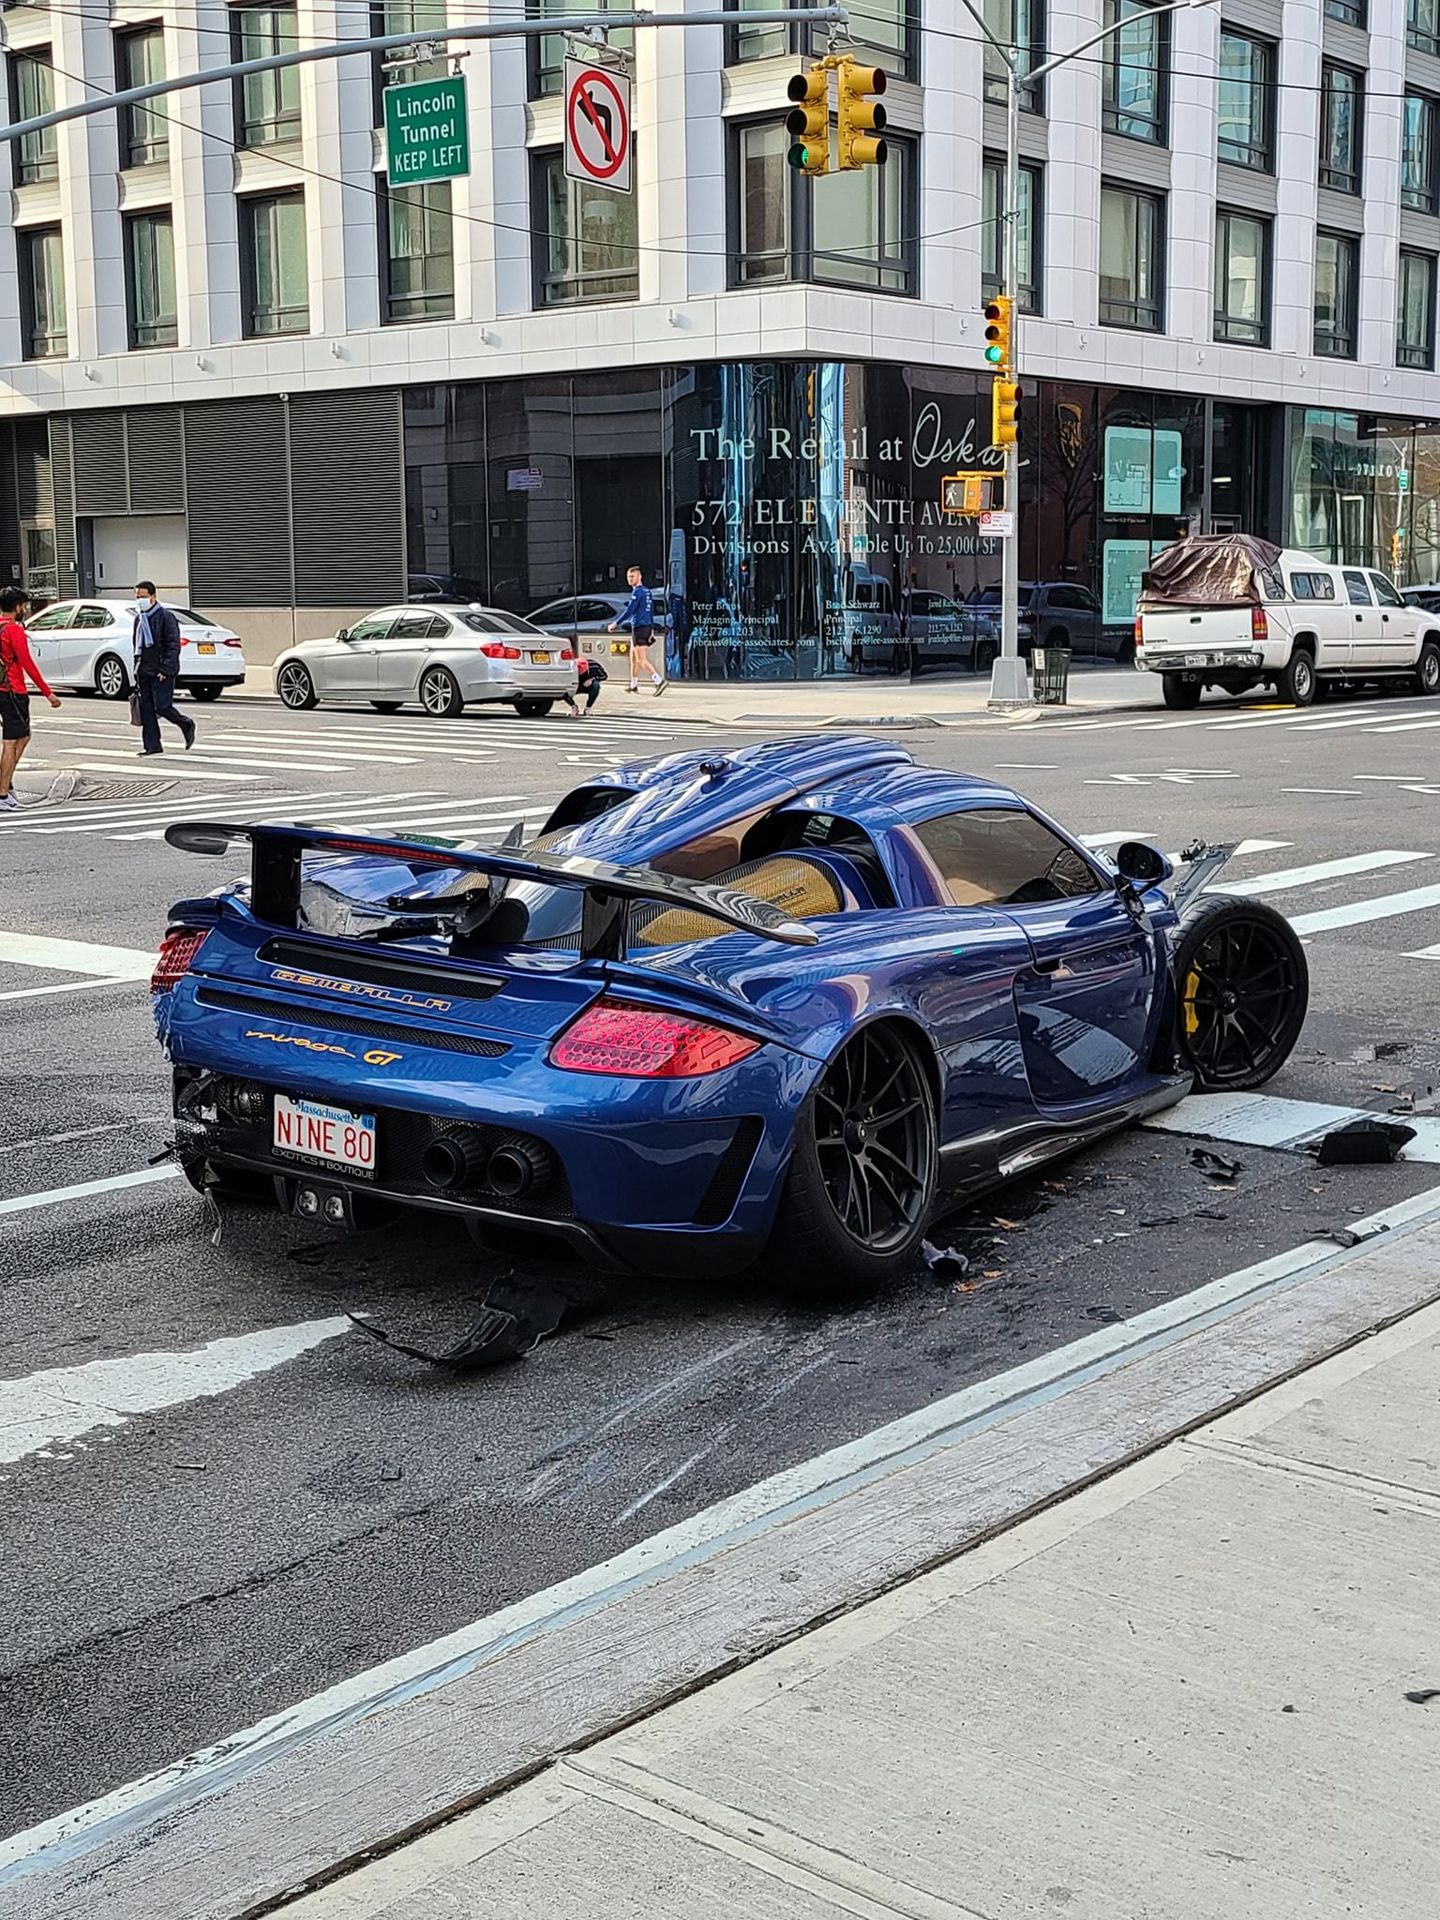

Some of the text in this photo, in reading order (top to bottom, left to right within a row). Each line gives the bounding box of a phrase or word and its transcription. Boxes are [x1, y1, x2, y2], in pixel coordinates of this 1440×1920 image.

[397, 92, 455, 118] Lincoln
[401, 118, 455, 145] Tunnel
[394, 145, 463, 173] KEEP LEFT
[690, 402, 1031, 468] The Retail at Oska
[691, 500, 743, 526] 572
[755, 499, 915, 525] ELEVENTH
[693, 534, 996, 558] Divisions Available Up To 25,000 SF
[692, 601, 713, 610] Peter
[738, 614, 779, 626] Principal
[271, 969, 451, 1012] GEMBALLA
[246, 1030, 403, 1066] mirage GT
[296, 1101, 355, 1125] Massachusetts
[278, 1110, 372, 1163] NINE 80
[272, 1147, 375, 1180] EXOTICS BOUTIQUE
